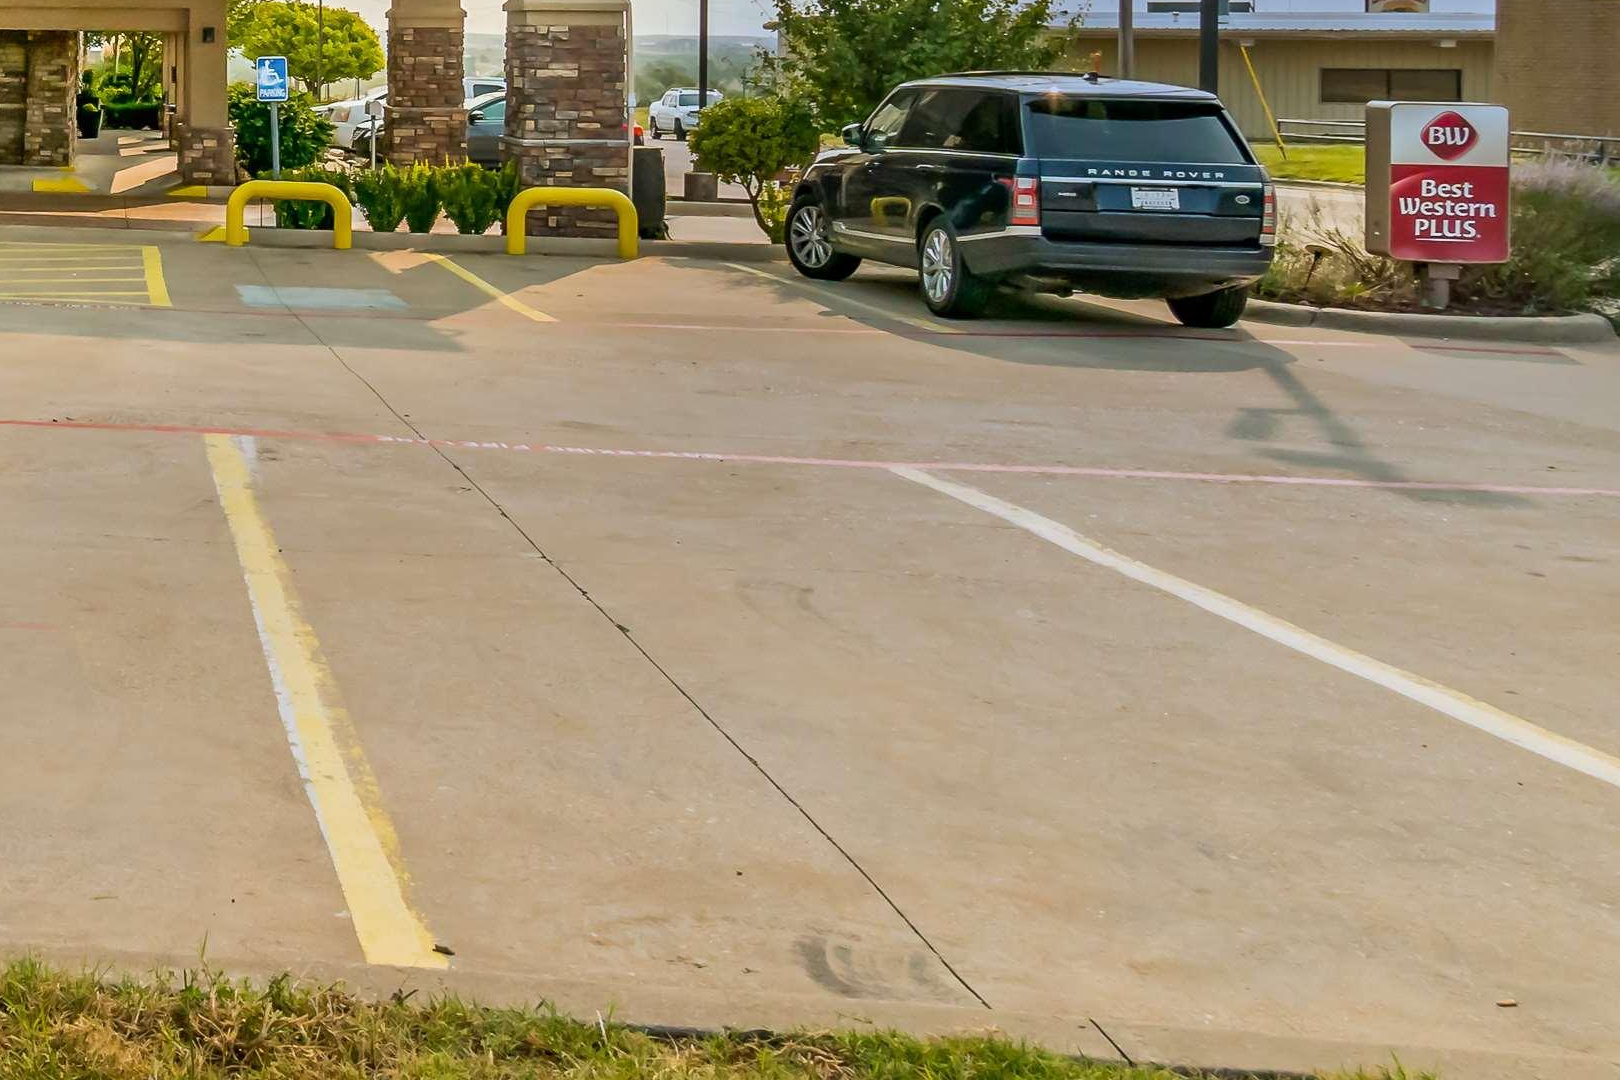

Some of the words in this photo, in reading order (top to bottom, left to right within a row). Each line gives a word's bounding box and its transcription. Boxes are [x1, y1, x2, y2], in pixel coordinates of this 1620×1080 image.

[1428, 126, 1470, 146] BW
[1087, 168, 1151, 177] RANGE
[1163, 170, 1225, 179] ROVER
[1420, 179, 1474, 199] Best
[1398, 197, 1496, 218] Western
[1414, 219, 1477, 238] PLUS
